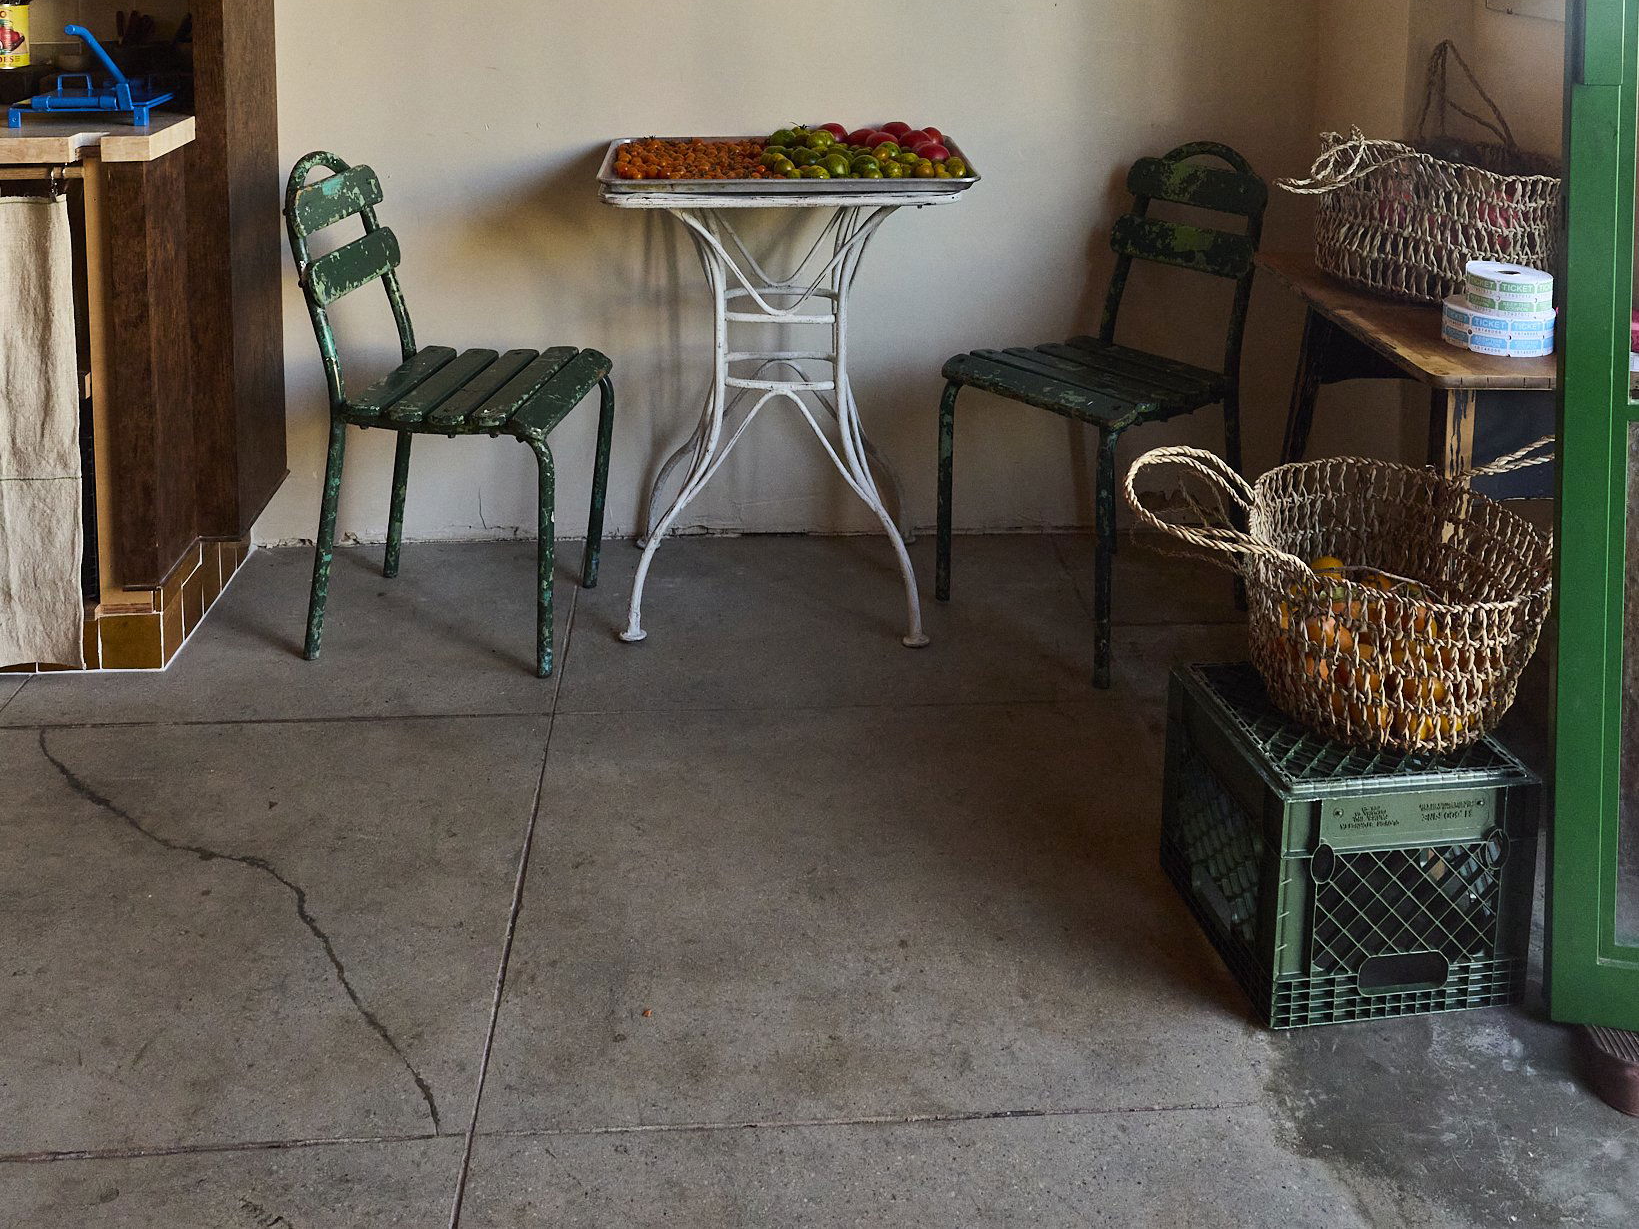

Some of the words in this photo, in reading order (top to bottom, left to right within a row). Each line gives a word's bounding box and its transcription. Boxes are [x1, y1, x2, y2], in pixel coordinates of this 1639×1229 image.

[1502, 283, 1534, 293] TICKET
[1474, 317, 1506, 329] TICKET
[1513, 322, 1541, 330] TICKET
